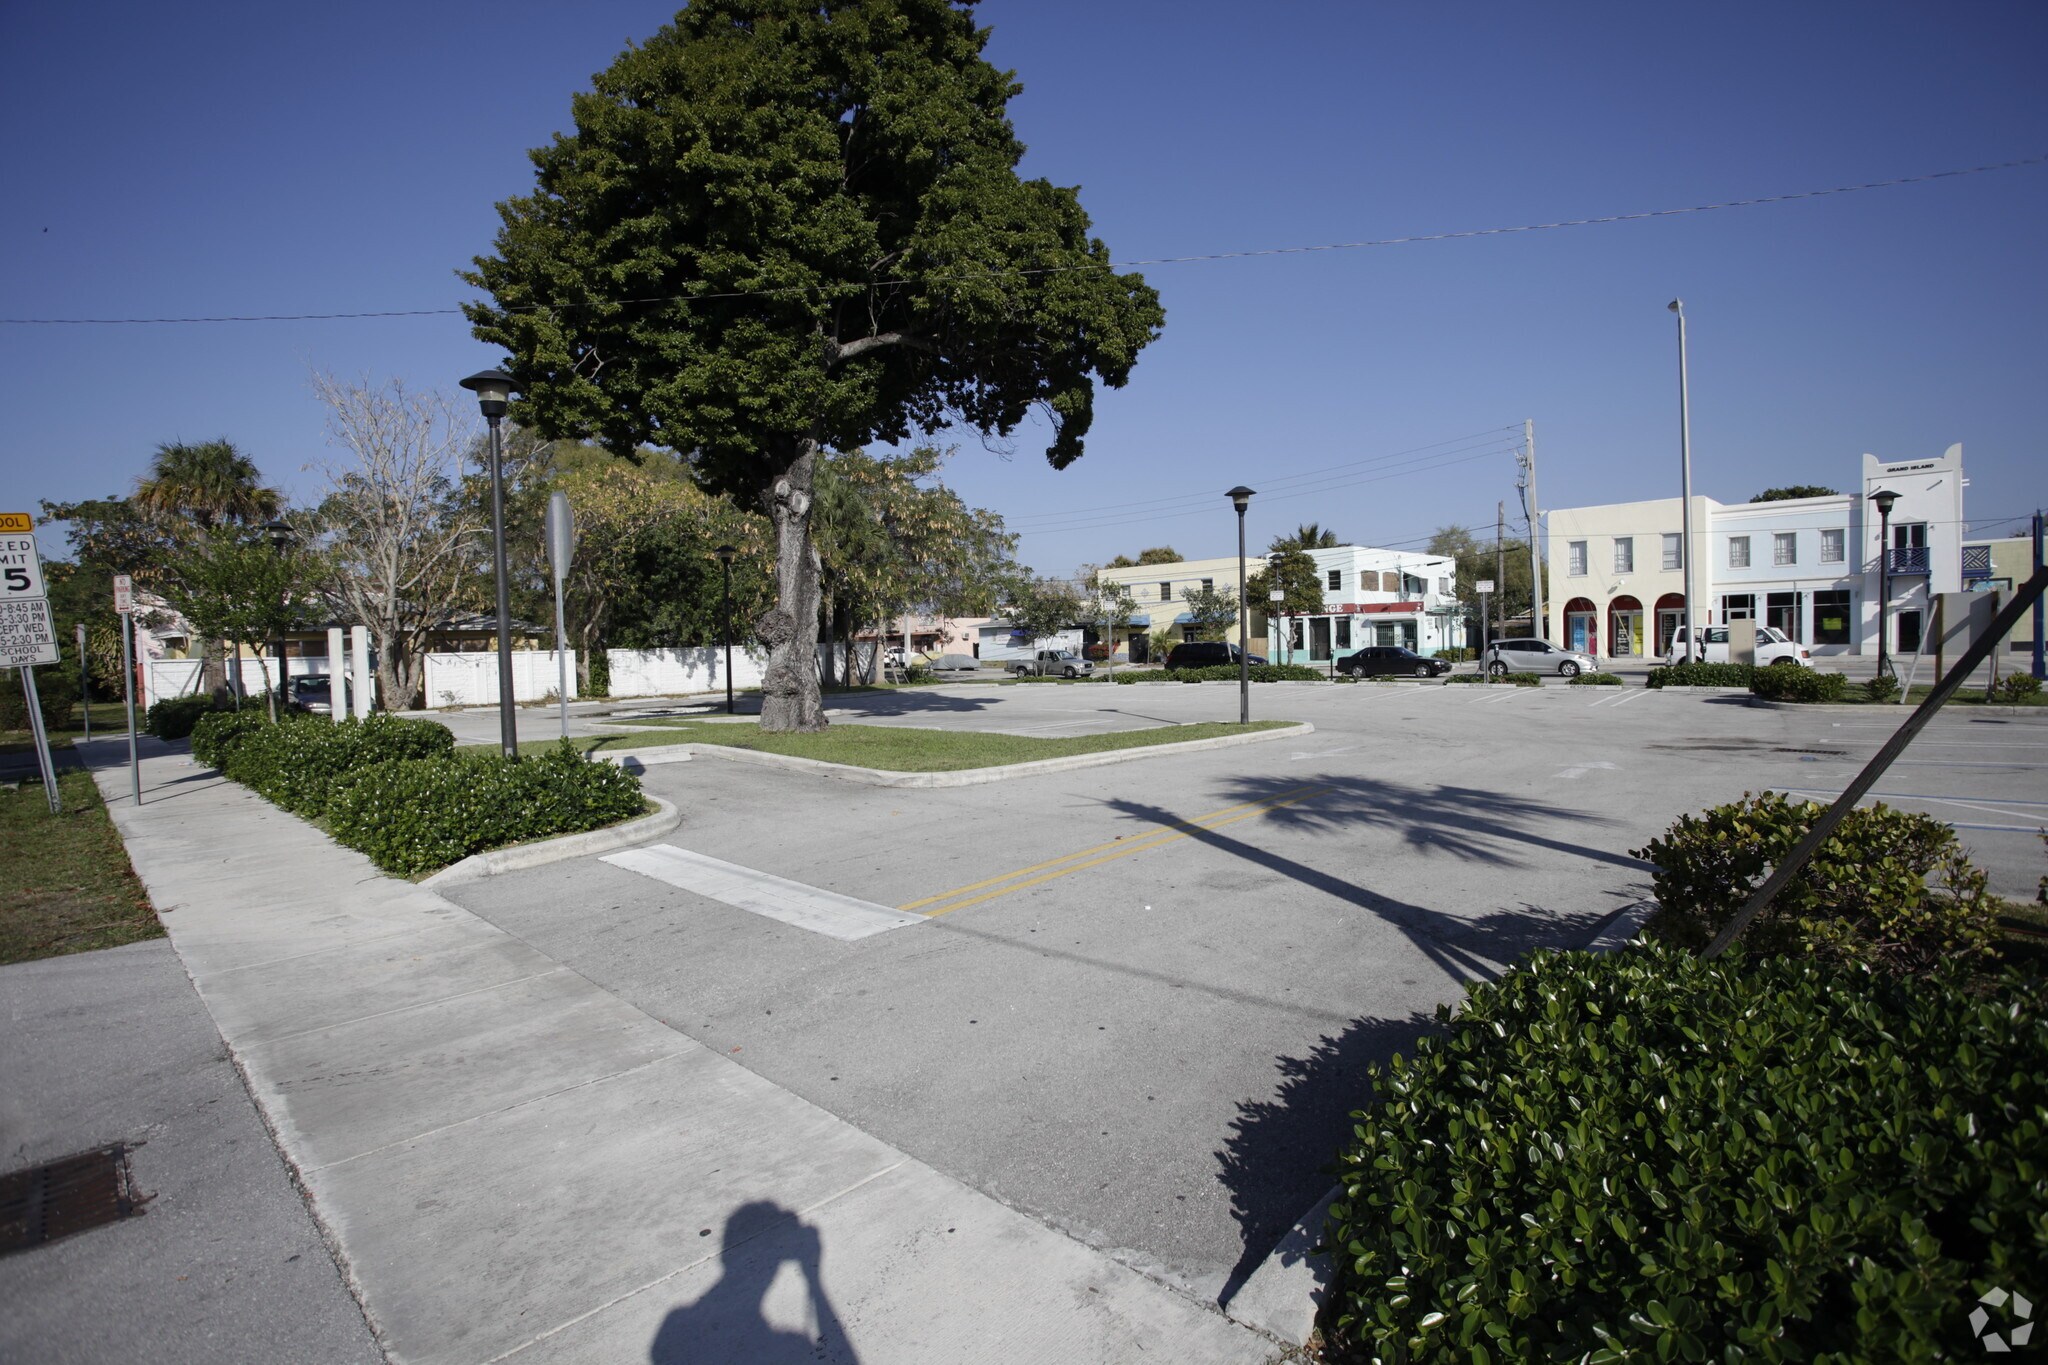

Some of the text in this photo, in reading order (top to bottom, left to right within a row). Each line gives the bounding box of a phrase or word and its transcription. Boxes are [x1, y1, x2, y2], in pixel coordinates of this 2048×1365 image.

[4, 568, 31, 591] 5
[30, 602, 44, 612] AM
[32, 612, 46, 622] PM
[0, 623, 47, 636] EPT WED.
[0, 633, 49, 646] 5-2:30 PM
[0, 646, 43, 656] SCHOOL
[11, 654, 37, 664] DAYS
